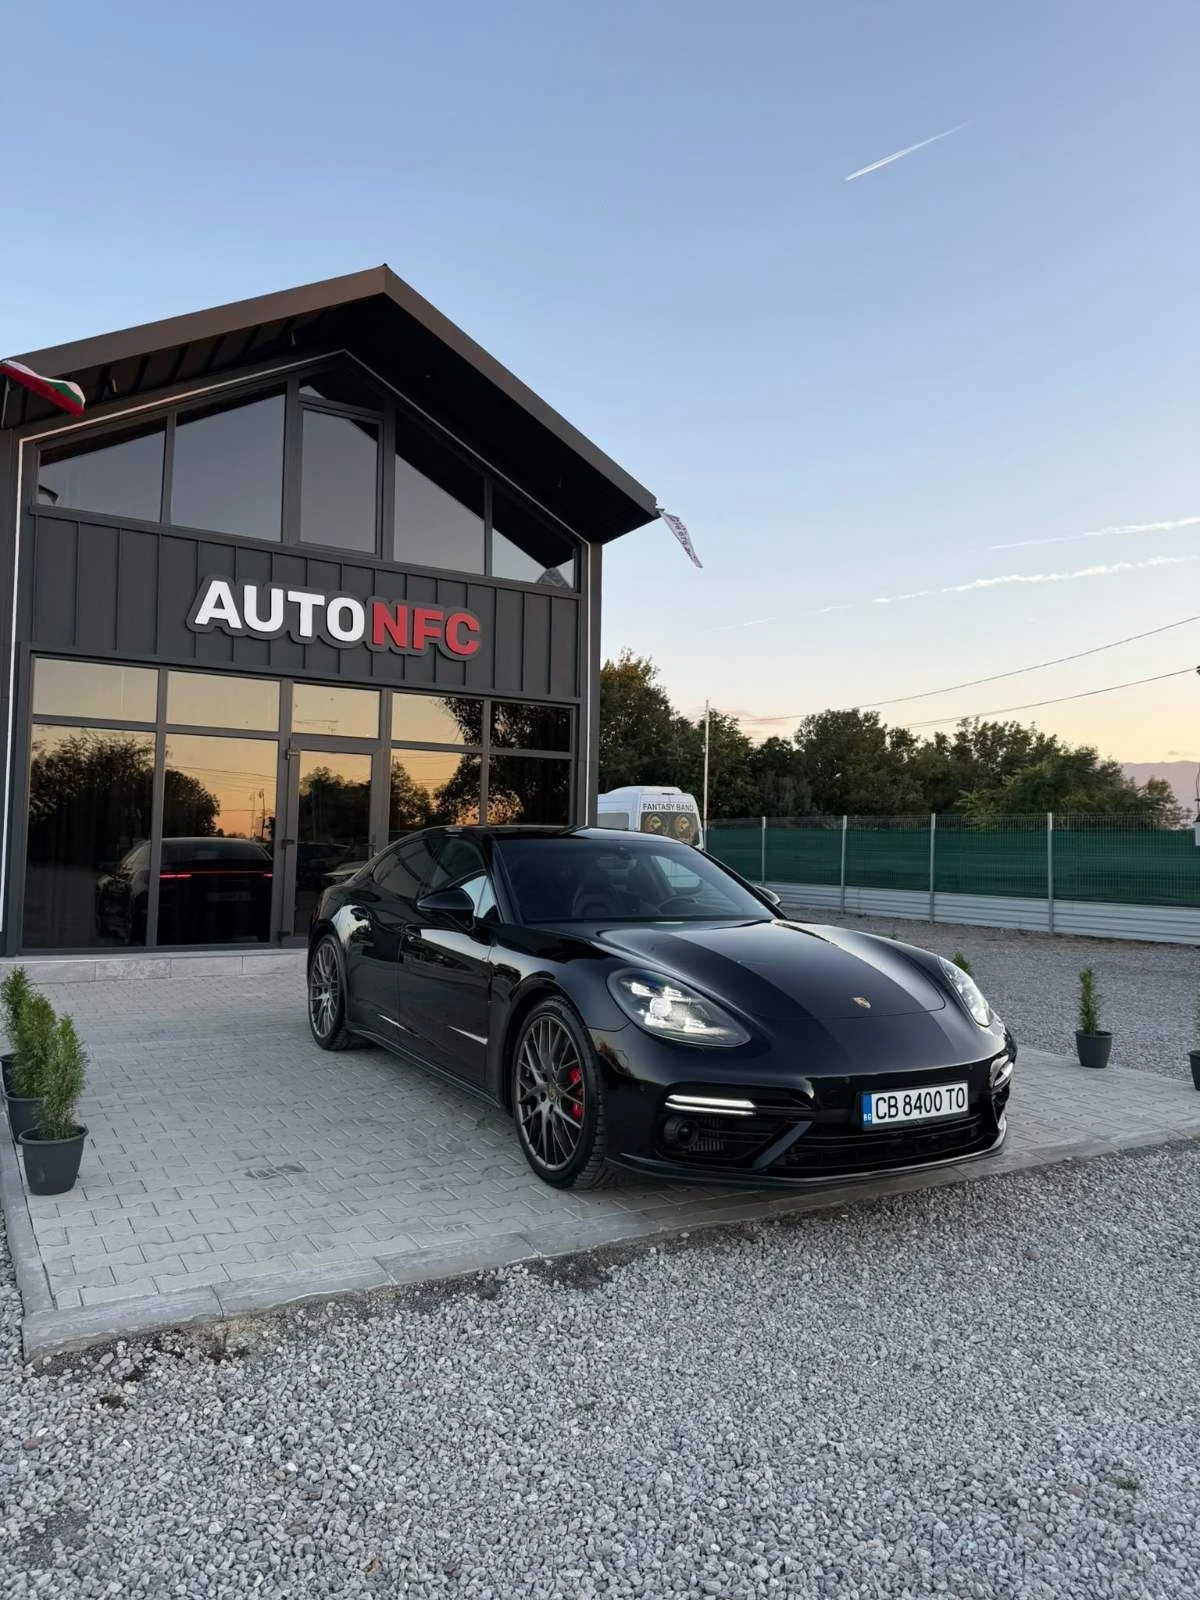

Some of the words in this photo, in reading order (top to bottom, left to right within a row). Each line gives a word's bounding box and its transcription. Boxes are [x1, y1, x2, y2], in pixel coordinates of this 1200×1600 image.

[642, 803, 674, 811] FANTASY
[676, 804, 694, 812] BAND
[875, 1096, 899, 1120] CB
[903, 1091, 943, 1116] 8400
[945, 1087, 966, 1110] TO
[863, 1113, 872, 1121] BG
